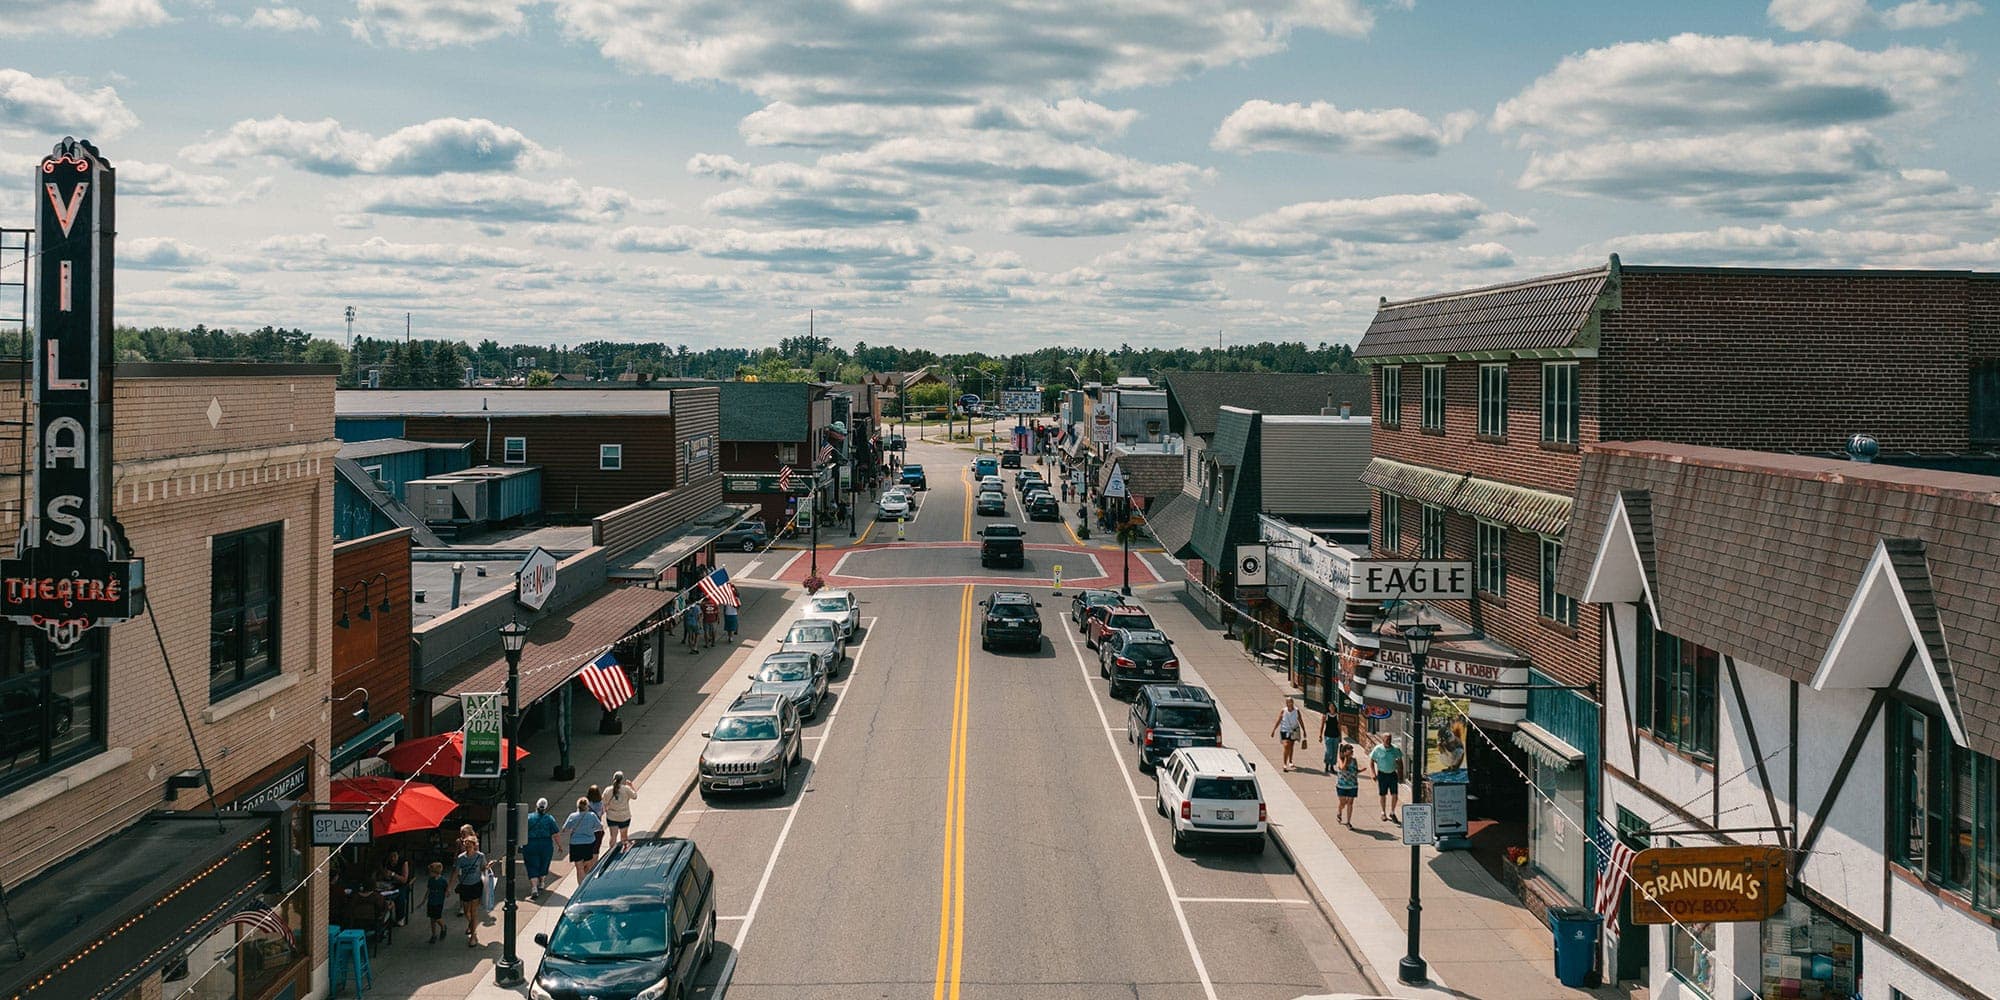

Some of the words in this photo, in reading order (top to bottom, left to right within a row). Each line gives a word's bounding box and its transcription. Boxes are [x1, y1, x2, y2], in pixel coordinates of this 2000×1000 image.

[45, 182, 90, 547] VILAS
[4, 577, 121, 602] THEATRE
[522, 563, 555, 595] BREAKAWAY
[1366, 567, 1465, 593] EAGLE
[1381, 650, 1413, 666] EAGLE
[1425, 656, 1449, 672] RAFT
[1454, 661, 1462, 674] &
[1465, 665, 1500, 680] HOBBY
[1384, 669, 1414, 685] SENIO
[1426, 676, 1459, 694] CRAFT
[1464, 683, 1492, 698] SHOP
[467, 696, 498, 709] ART
[467, 710, 499, 720] SCAPE
[467, 720, 498, 733] 2024
[266, 770, 305, 801] COMPANY
[1642, 867, 1761, 901] GRANDMA'S
